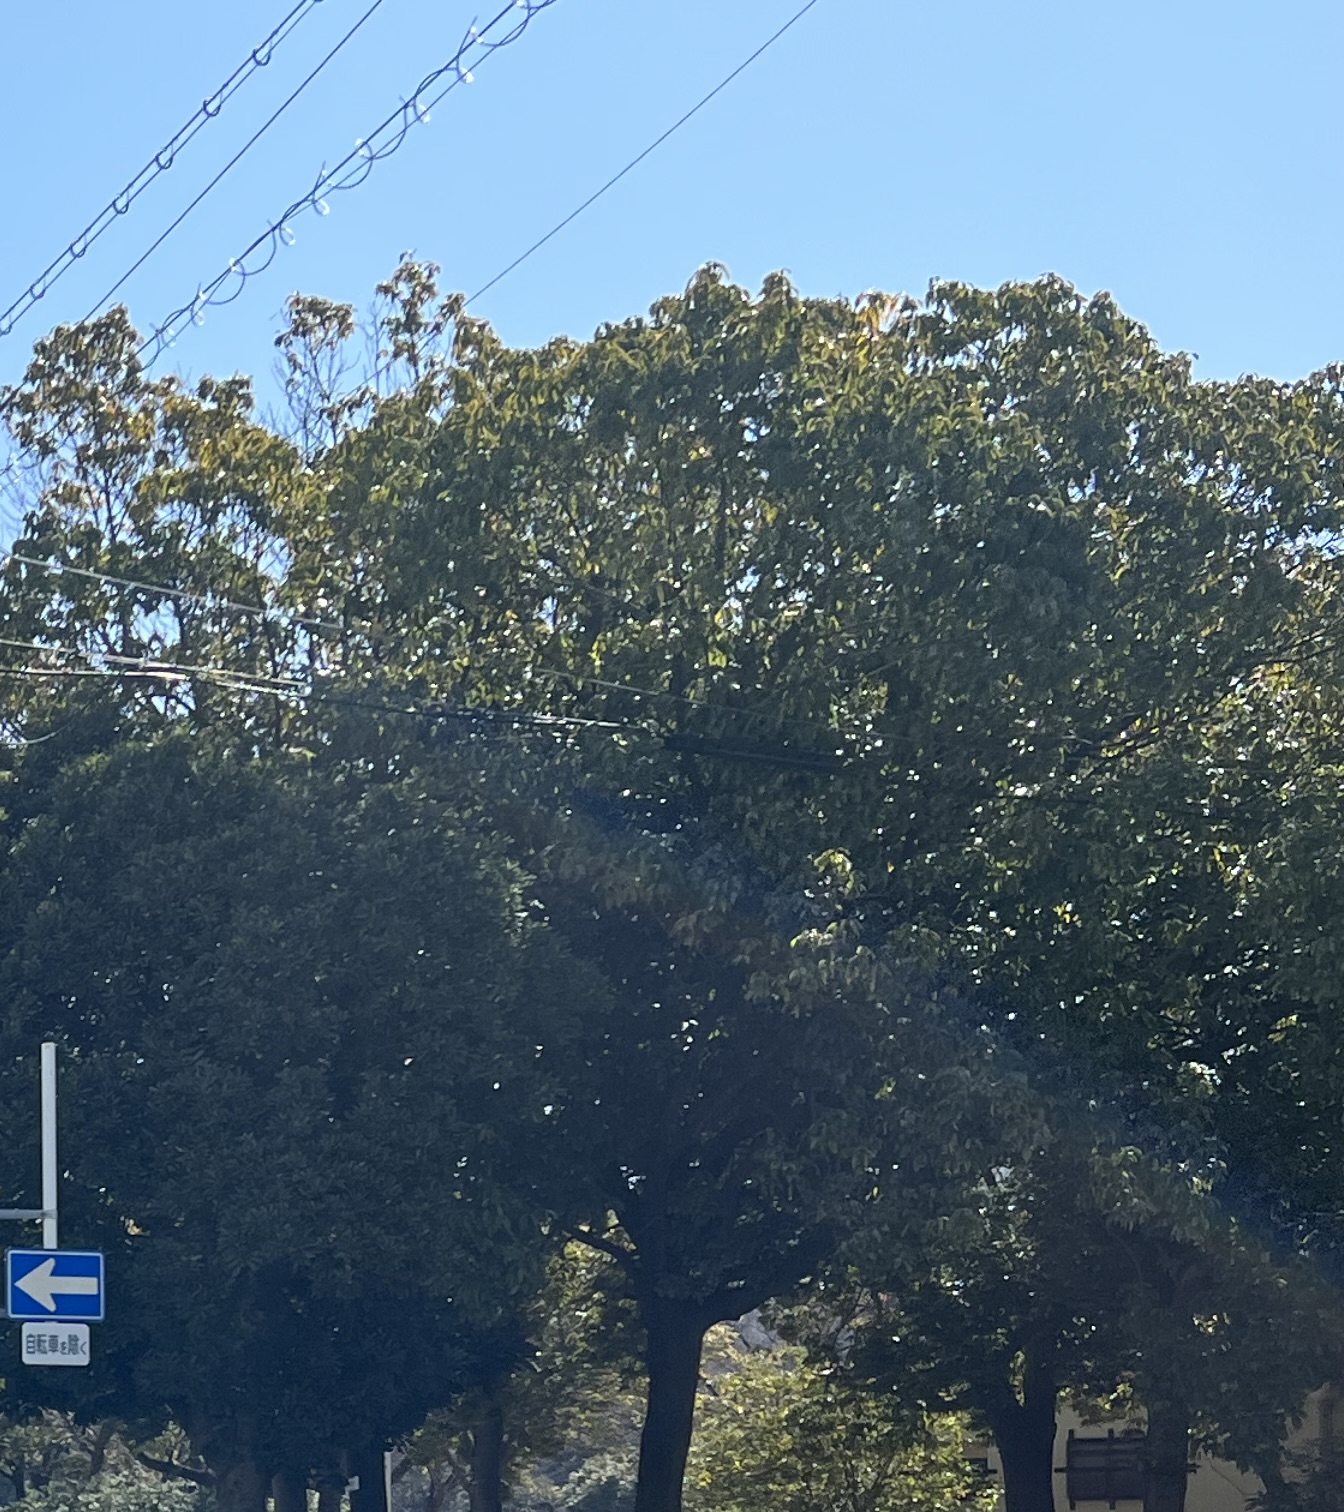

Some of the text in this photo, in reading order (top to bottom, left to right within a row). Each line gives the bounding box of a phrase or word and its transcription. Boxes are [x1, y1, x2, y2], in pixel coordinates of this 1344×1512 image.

[26, 1333, 87, 1355] 自転車を除く
